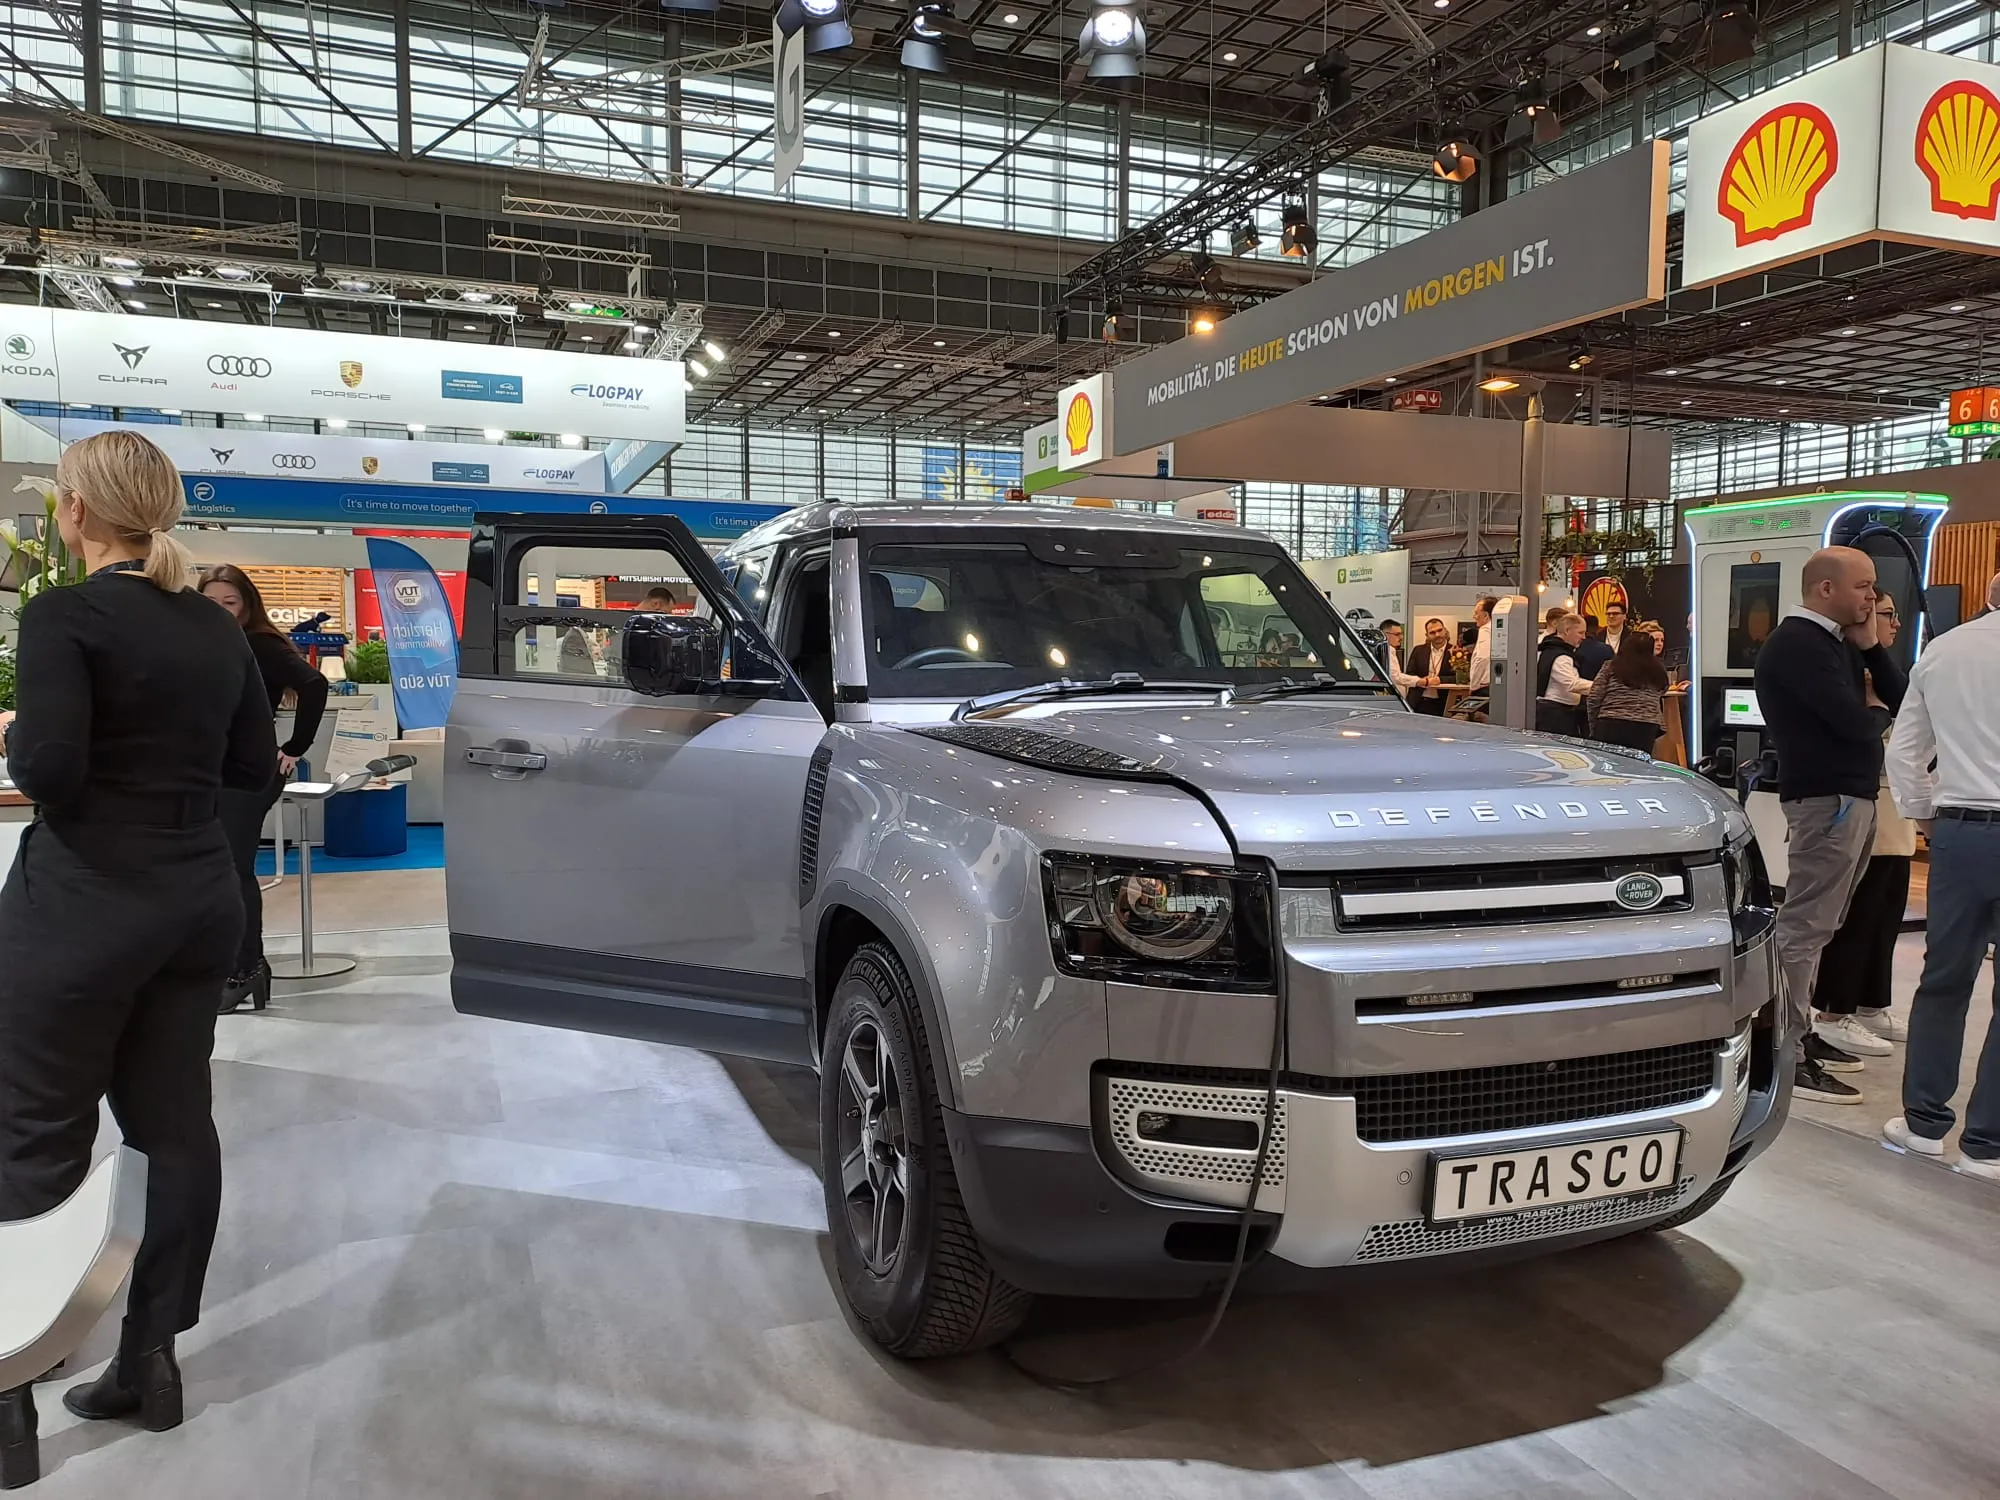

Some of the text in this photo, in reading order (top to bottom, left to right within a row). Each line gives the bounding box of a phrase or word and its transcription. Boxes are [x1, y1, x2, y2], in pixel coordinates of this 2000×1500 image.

[1148, 239, 1554, 407] MOBILITÄT, DIE HEUTE SCHON VON MORGEN IST.
[98, 374, 167, 385] CUPRA
[210, 382, 237, 391] Audi
[311, 389, 391, 401] PORSCHE
[588, 384, 644, 401] LOGPAY
[1960, 399, 1971, 420] 6
[1990, 398, 1999, 419] 6
[536, 469, 575, 480] LOGPAY
[347, 498, 473, 514] It's time to move together
[715, 516, 729, 525] It's
[730, 517, 749, 526] time
[1328, 797, 1670, 829] DEFENDER
[1626, 882, 1646, 891] LAND
[1629, 889, 1653, 900] ROVER
[850, 959, 893, 1004] MICHELIN
[890, 1012, 905, 1044] PILOT
[900, 1052, 914, 1093] ALPIN
[1452, 1139, 1663, 1210] TRASCO
[1486, 1196, 1629, 1226] www.TRASCO-BREMEN.de
